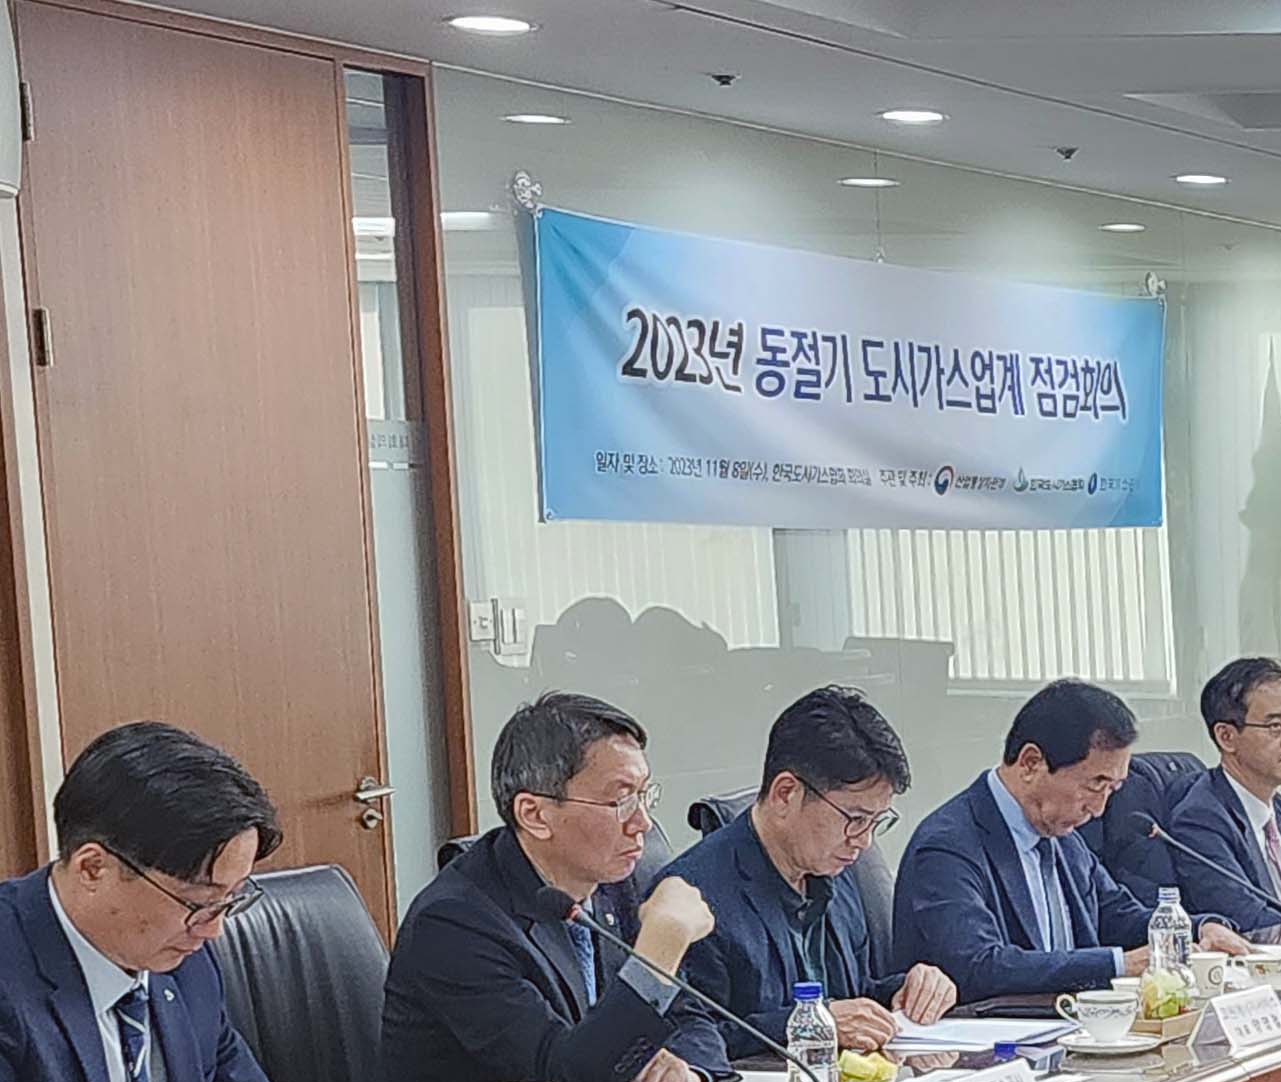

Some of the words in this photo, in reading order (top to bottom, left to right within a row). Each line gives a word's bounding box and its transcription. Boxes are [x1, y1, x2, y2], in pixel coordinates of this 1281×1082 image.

[621, 307, 744, 393] 2023년
[755, 327, 853, 402] 동절기
[862, 339, 1026, 416] 도시가스업계
[1028, 356, 1127, 420] 점검회의
[596, 451, 619, 473] 일자
[623, 453, 635, 474] 및
[668, 456, 702, 477] 2023년
[707, 459, 730, 479] 11월
[879, 469, 896, 488] 주관
[897, 470, 907, 487] 및
